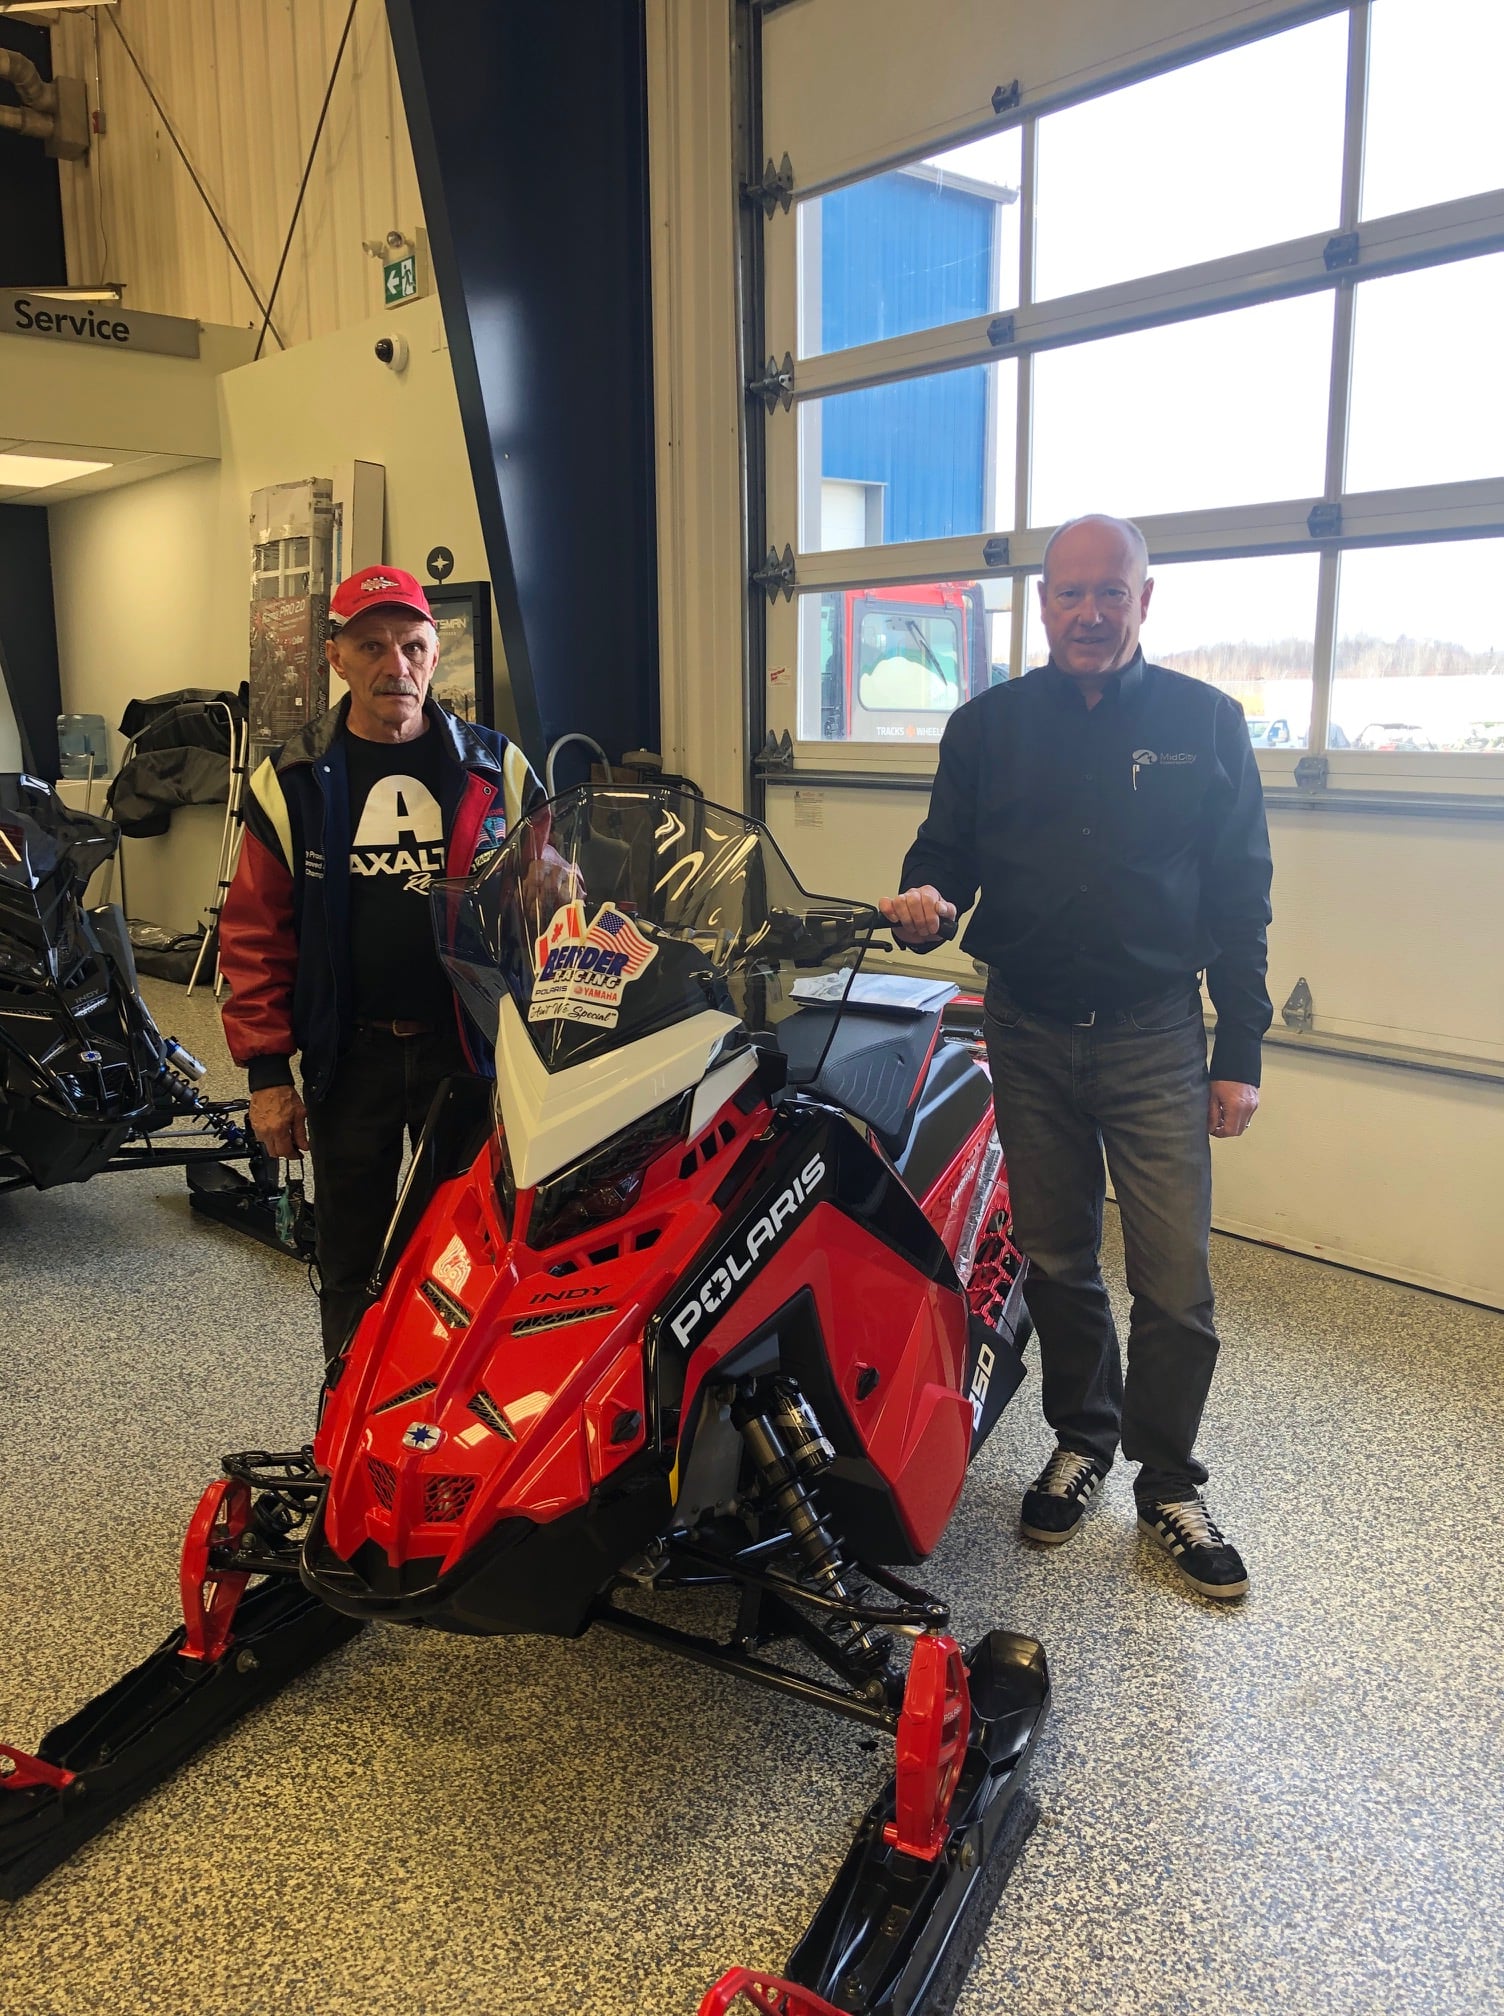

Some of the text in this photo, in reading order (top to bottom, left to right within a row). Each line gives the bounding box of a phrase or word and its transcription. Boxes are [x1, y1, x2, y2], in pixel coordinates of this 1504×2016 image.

[14, 299, 130, 342] Service
[280, 602, 295, 617] PRO
[318, 618, 326, 640] PRO
[876, 726, 905, 736] TRACKS
[539, 945, 630, 982] BENDER
[552, 968, 621, 989] RACING
[535, 985, 618, 1002] POLARIS YAMAHA
[670, 1152, 827, 1349] POLARIS
[528, 1284, 614, 1305] INDY
